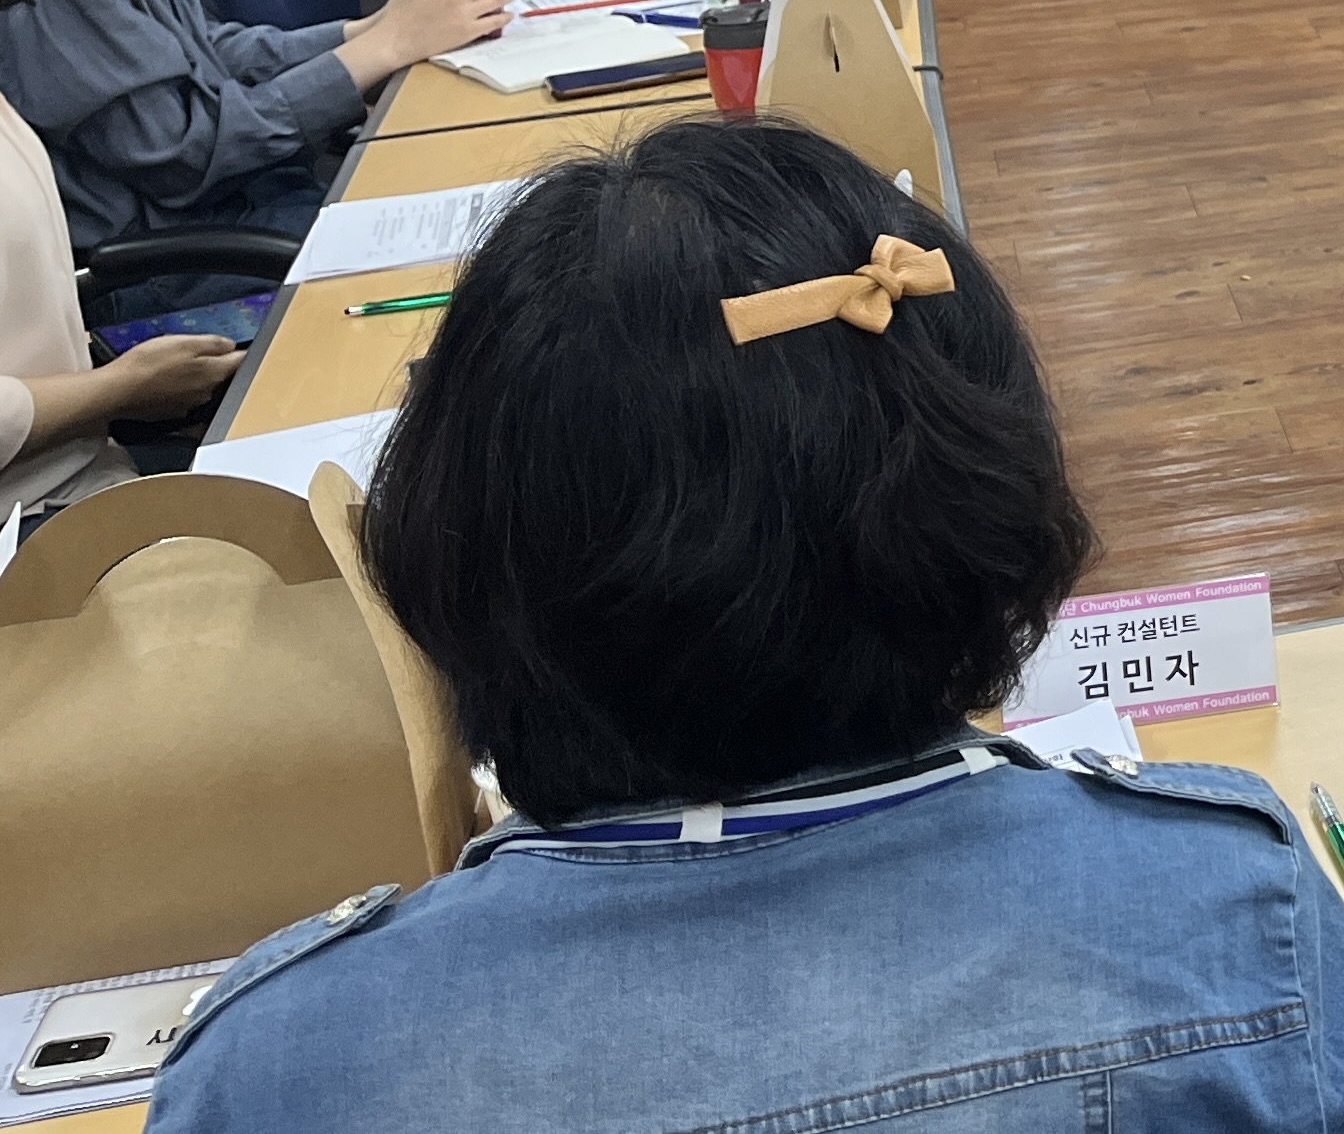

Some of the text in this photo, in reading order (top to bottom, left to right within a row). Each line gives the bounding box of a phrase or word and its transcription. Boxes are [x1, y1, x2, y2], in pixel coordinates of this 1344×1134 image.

[1080, 595, 1142, 613] Chungbuk
[1146, 589, 1191, 605] Women
[1195, 580, 1262, 598] Foundation
[1069, 614, 1201, 649] 신규 컨설턴트
[1077, 650, 1200, 700] 김민자
[1153, 700, 1199, 717] Women
[1202, 690, 1270, 709] Foundation
